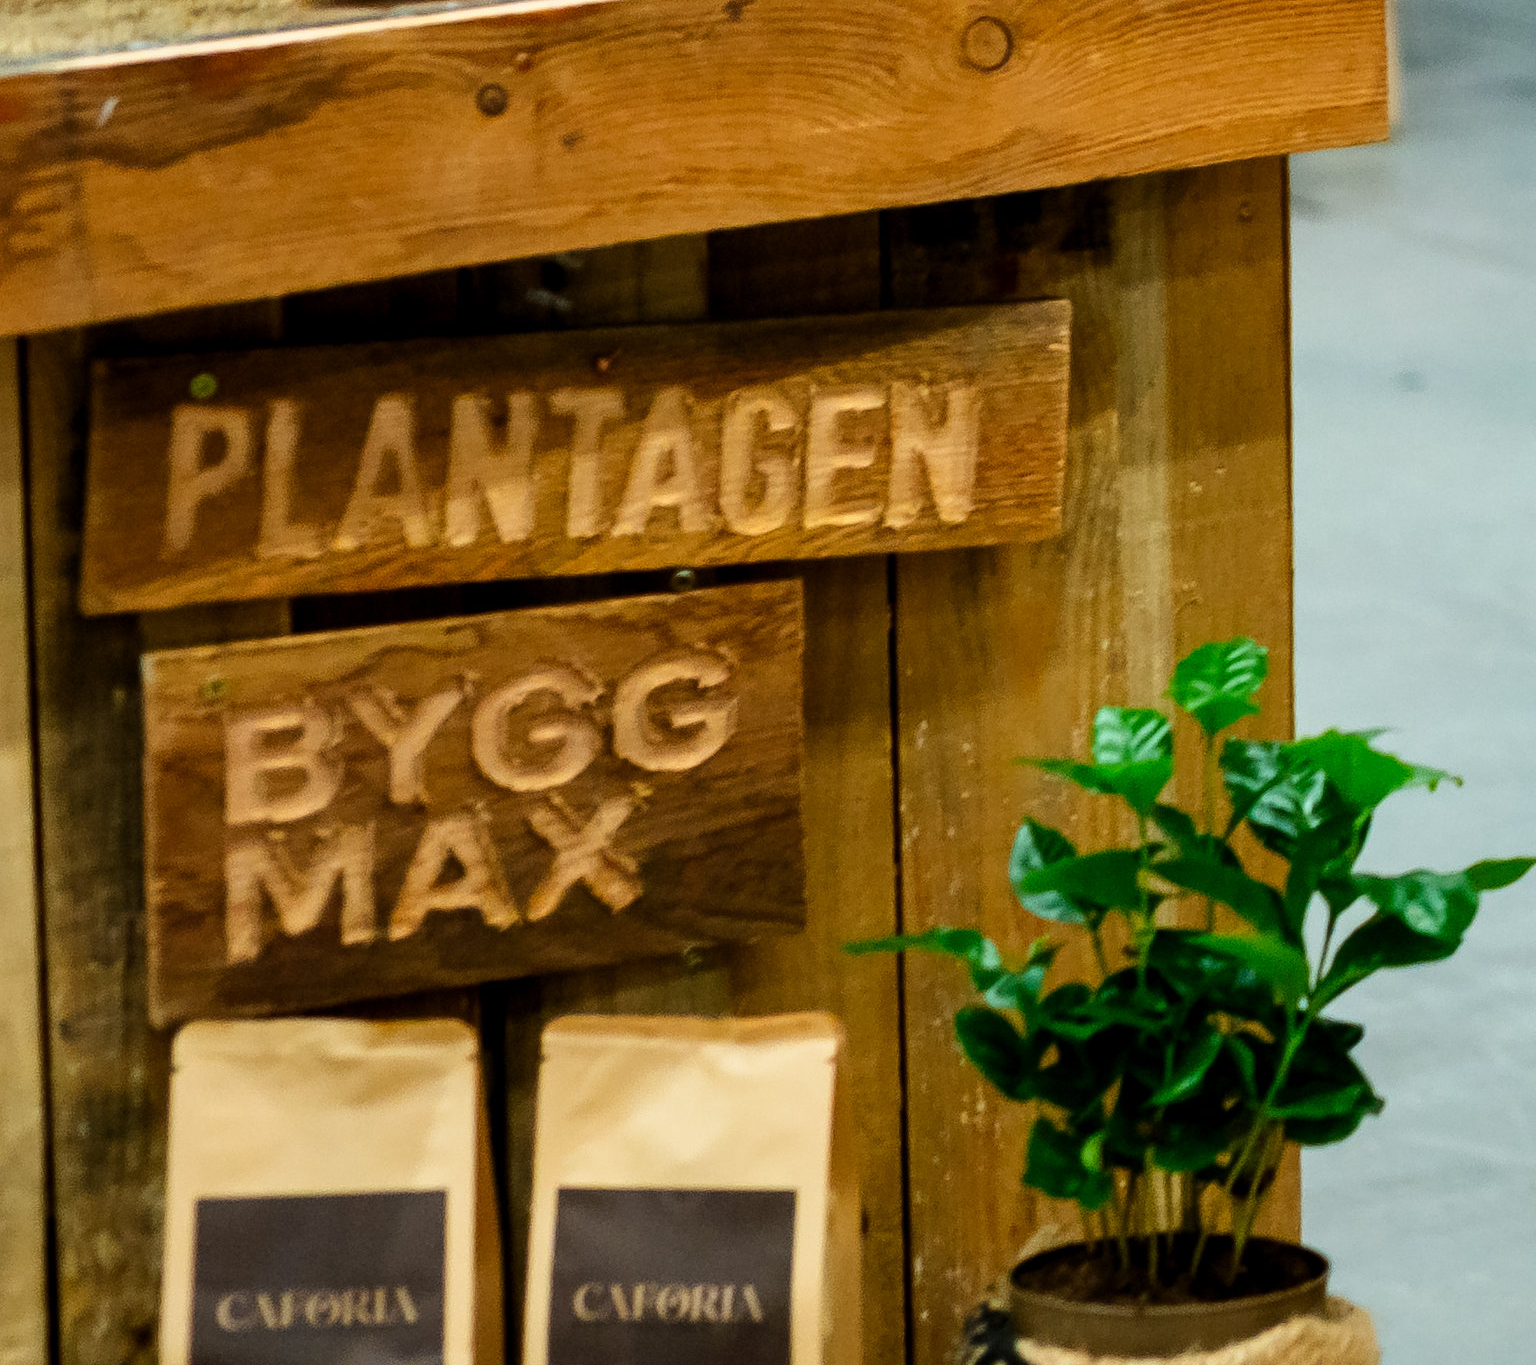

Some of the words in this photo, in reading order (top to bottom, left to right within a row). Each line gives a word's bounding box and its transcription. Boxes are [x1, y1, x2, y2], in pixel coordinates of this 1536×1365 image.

[161, 376, 983, 559] PLANTAGEN
[223, 644, 740, 825] BYGG
[225, 792, 648, 965] MAX
